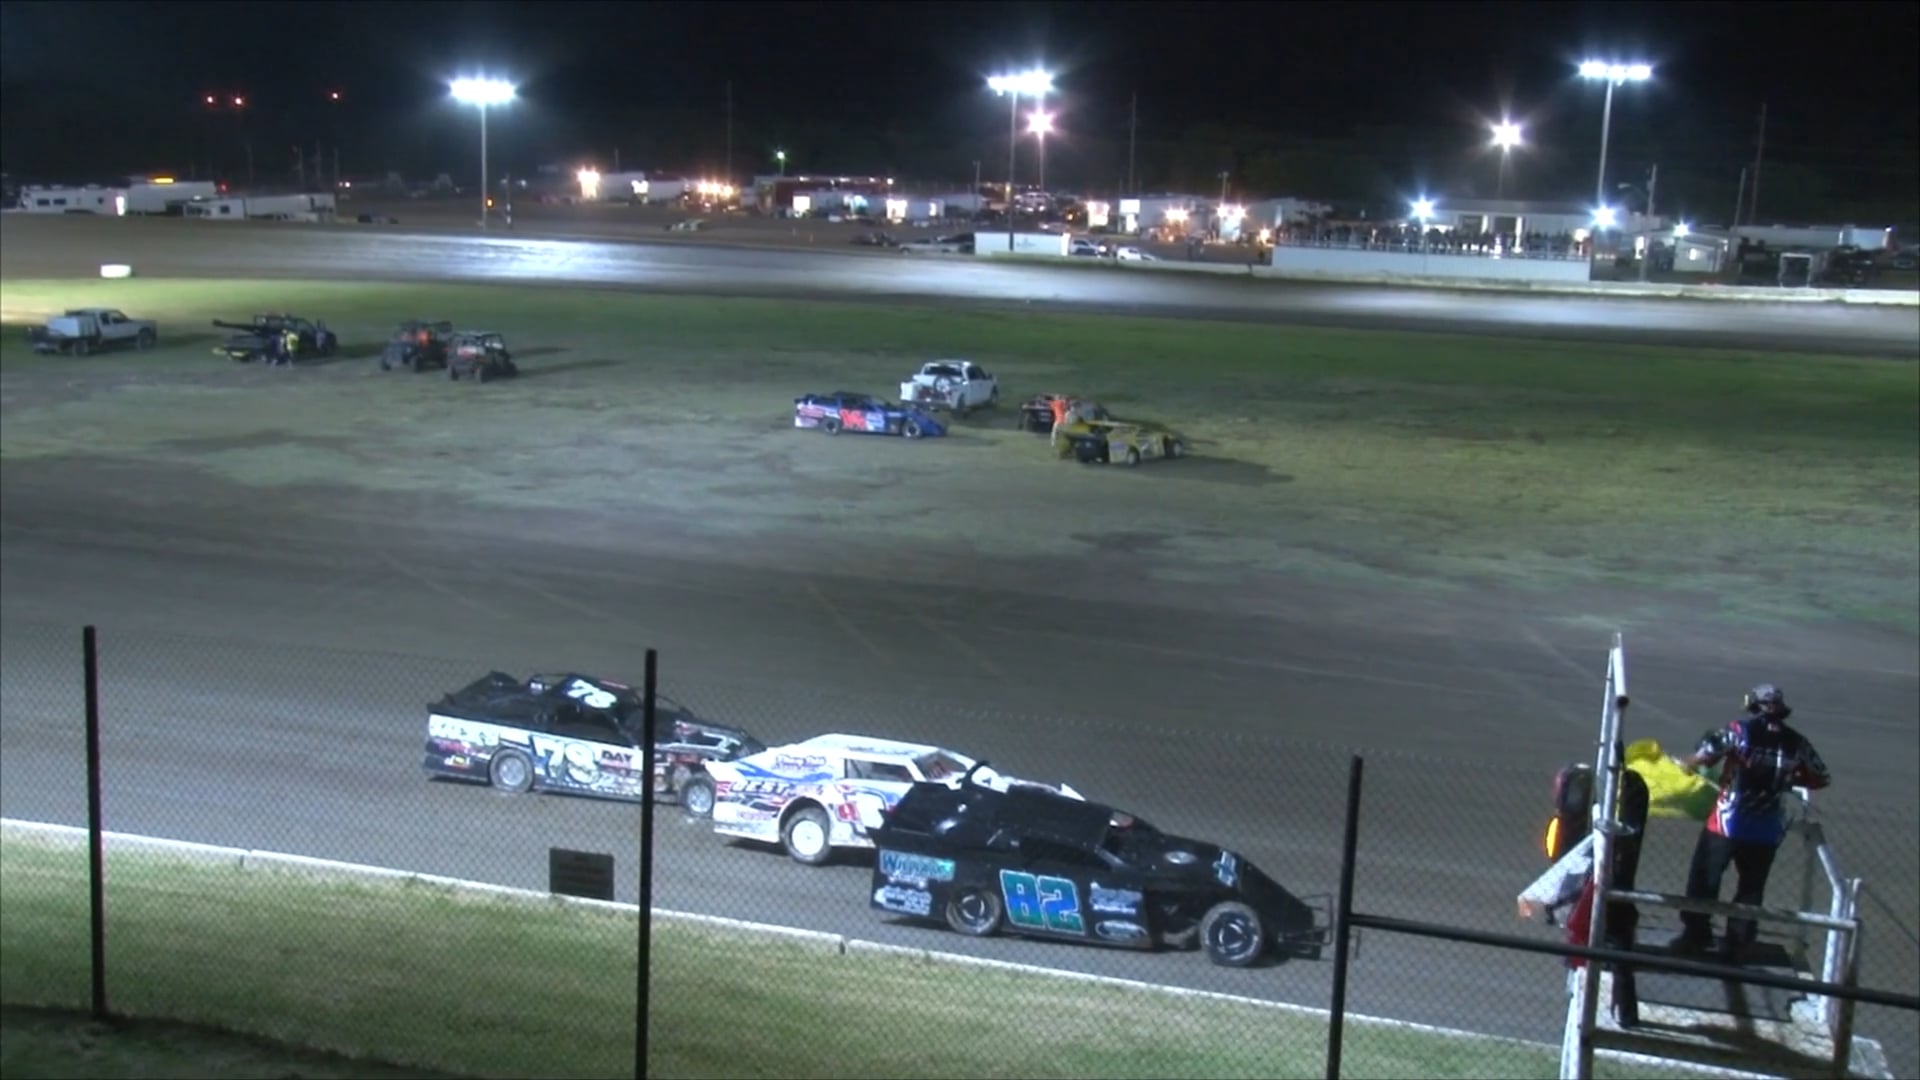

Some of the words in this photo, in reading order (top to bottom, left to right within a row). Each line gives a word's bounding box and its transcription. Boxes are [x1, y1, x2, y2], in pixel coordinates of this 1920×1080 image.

[567, 679, 617, 709] 78
[529, 736, 599, 784] 78
[602, 749, 634, 763] DAY
[1000, 869, 1086, 936] 82
